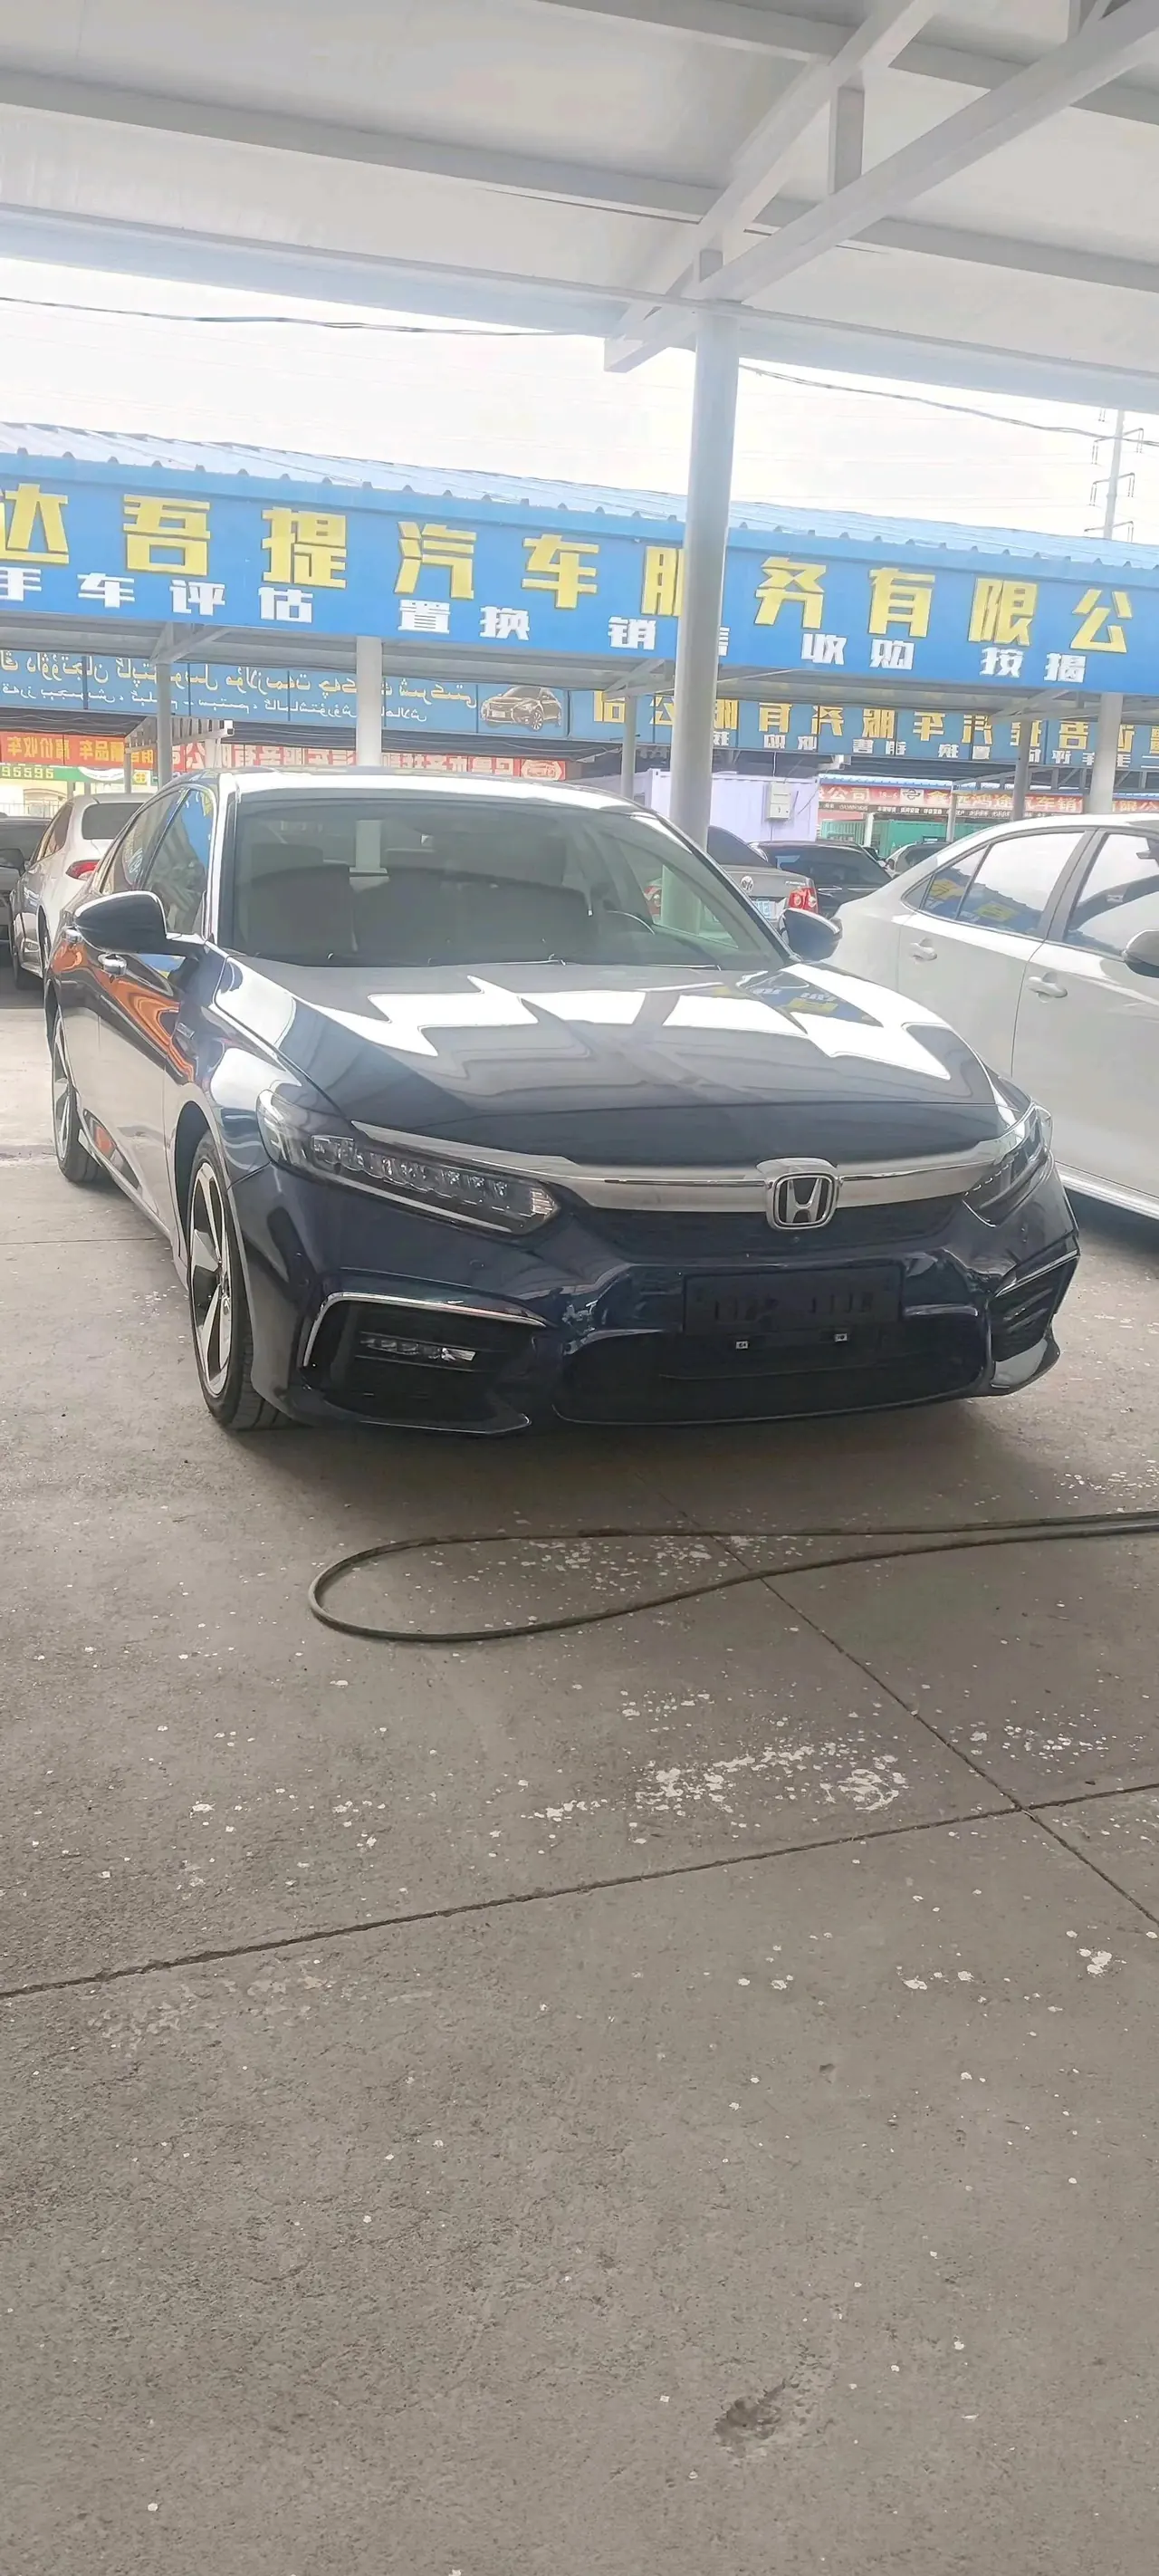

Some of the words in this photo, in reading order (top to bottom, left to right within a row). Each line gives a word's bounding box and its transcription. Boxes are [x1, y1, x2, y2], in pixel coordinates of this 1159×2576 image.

[398, 599, 531, 641] 置换
[608, 616, 730, 657] 销
[801, 632, 915, 670] 收购
[979, 646, 1086, 683] 按揭
